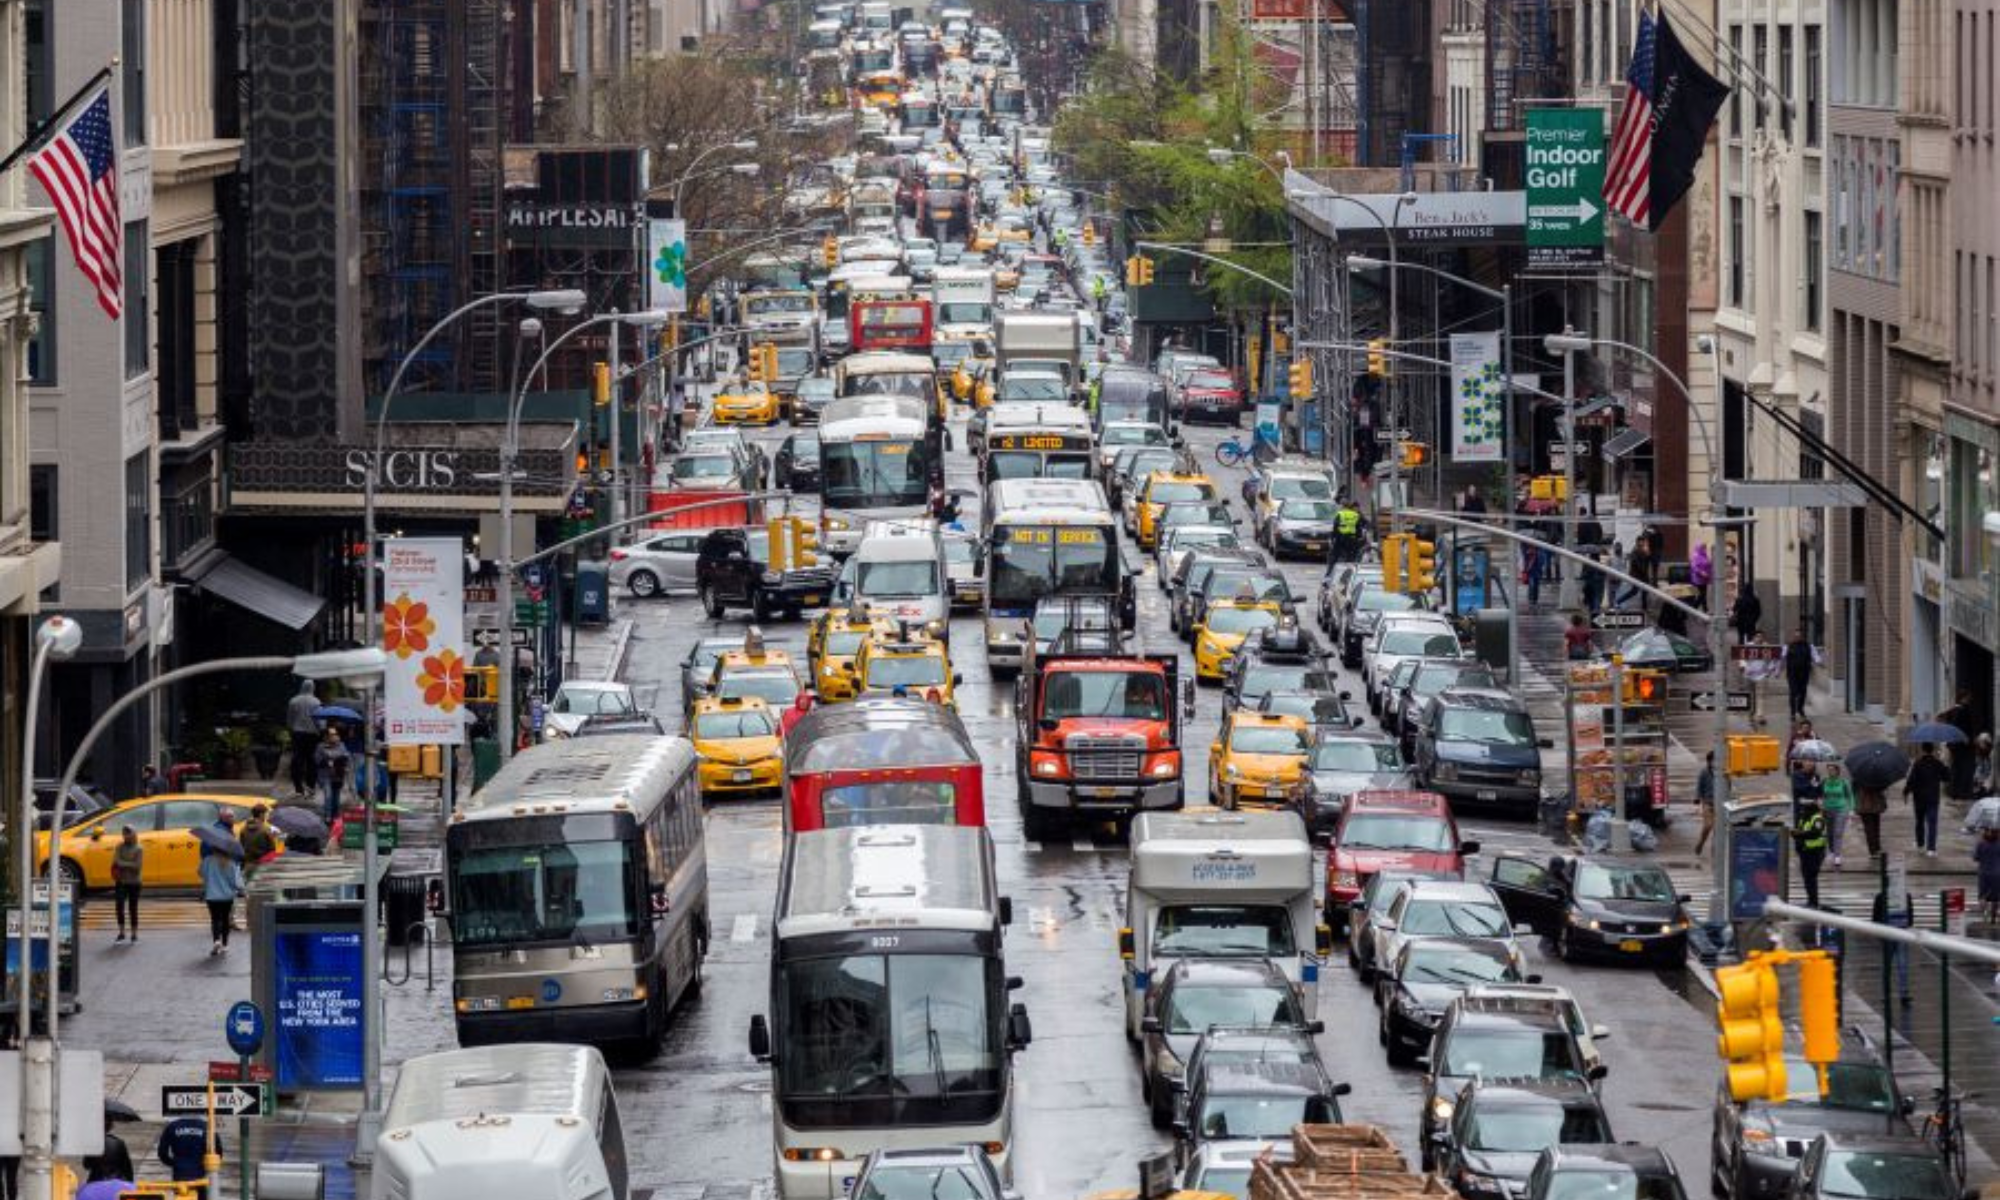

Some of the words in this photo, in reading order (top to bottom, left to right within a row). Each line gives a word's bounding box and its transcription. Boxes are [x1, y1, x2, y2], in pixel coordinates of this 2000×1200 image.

[1526, 127, 1587, 142] Premier
[1526, 145, 1602, 165] Indoor
[1527, 167, 1578, 188] Golf
[1408, 228, 1448, 239] STEAK
[1452, 226, 1495, 237] HOUSE
[1024, 436, 1064, 448] LIMITED
[345, 449, 455, 489] SICIS
[1014, 529, 1032, 543] NOT
[1059, 530, 1097, 543] SERVICE
[317, 990, 343, 998] MOST
[297, 1000, 323, 1009] CITIES
[326, 999, 361, 1008] SERVED
[297, 1009, 323, 1017] FROM
[326, 1009, 342, 1017] THE
[282, 1017, 303, 1026] NEW
[306, 1018, 330, 1026] YORK
[333, 1017, 357, 1025] AREA
[175, 1094, 204, 1107] ONE
[217, 1094, 245, 1107] WAY
